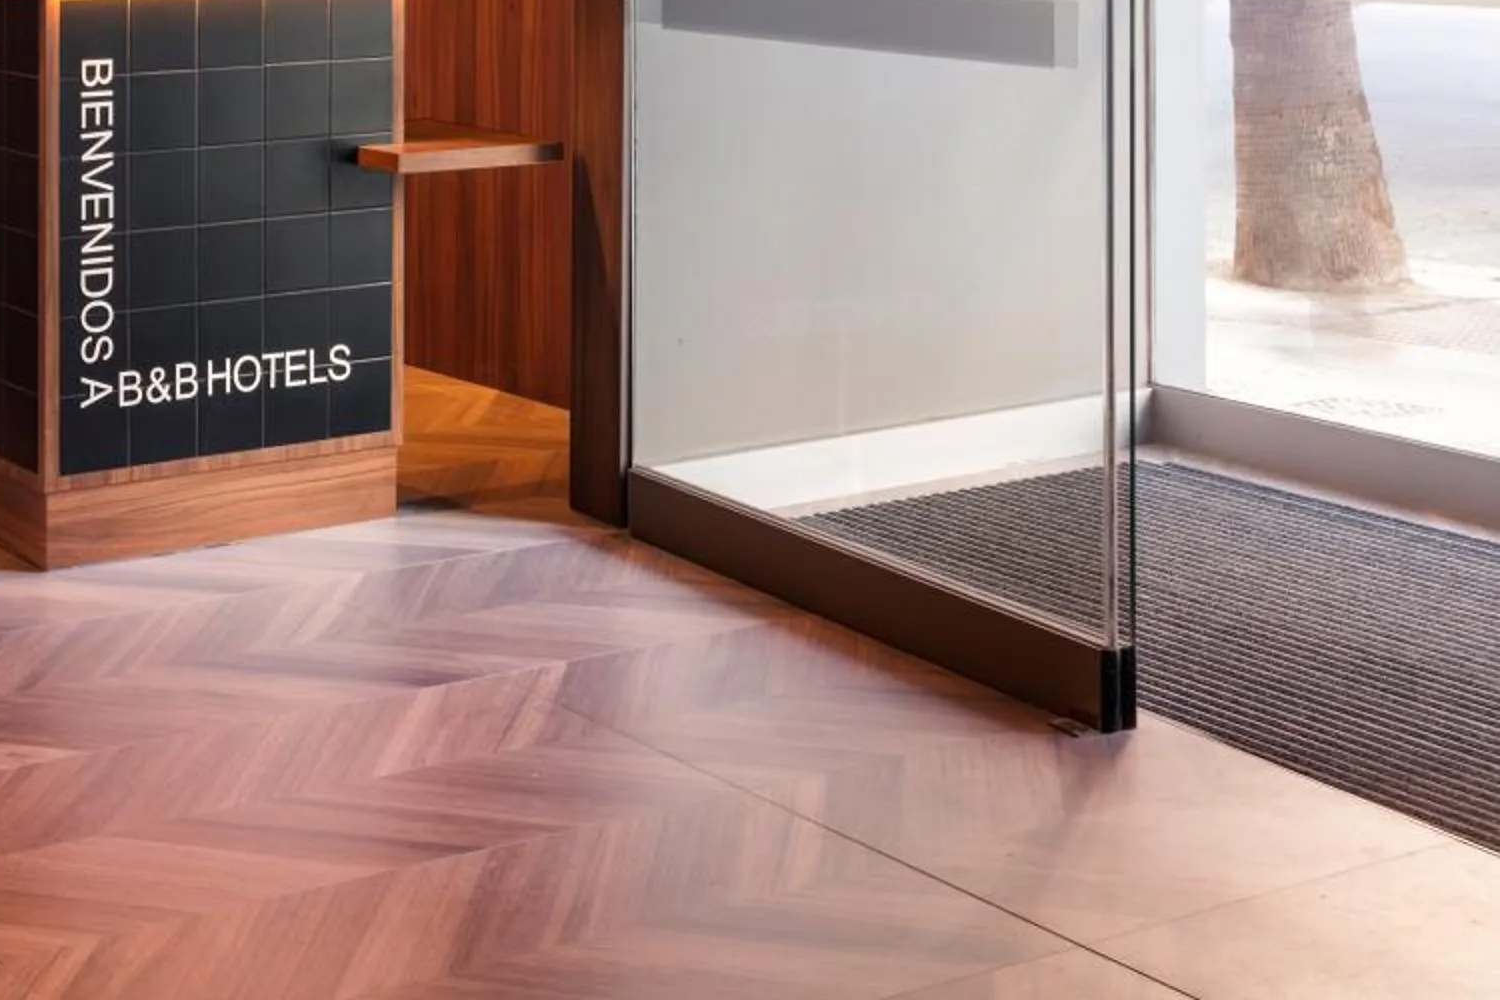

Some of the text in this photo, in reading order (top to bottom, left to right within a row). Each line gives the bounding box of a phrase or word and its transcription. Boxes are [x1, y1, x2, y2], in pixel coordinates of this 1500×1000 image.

[79, 57, 115, 409] BIENVENIDOS A
[117, 343, 352, 408] B&B HOTELS
